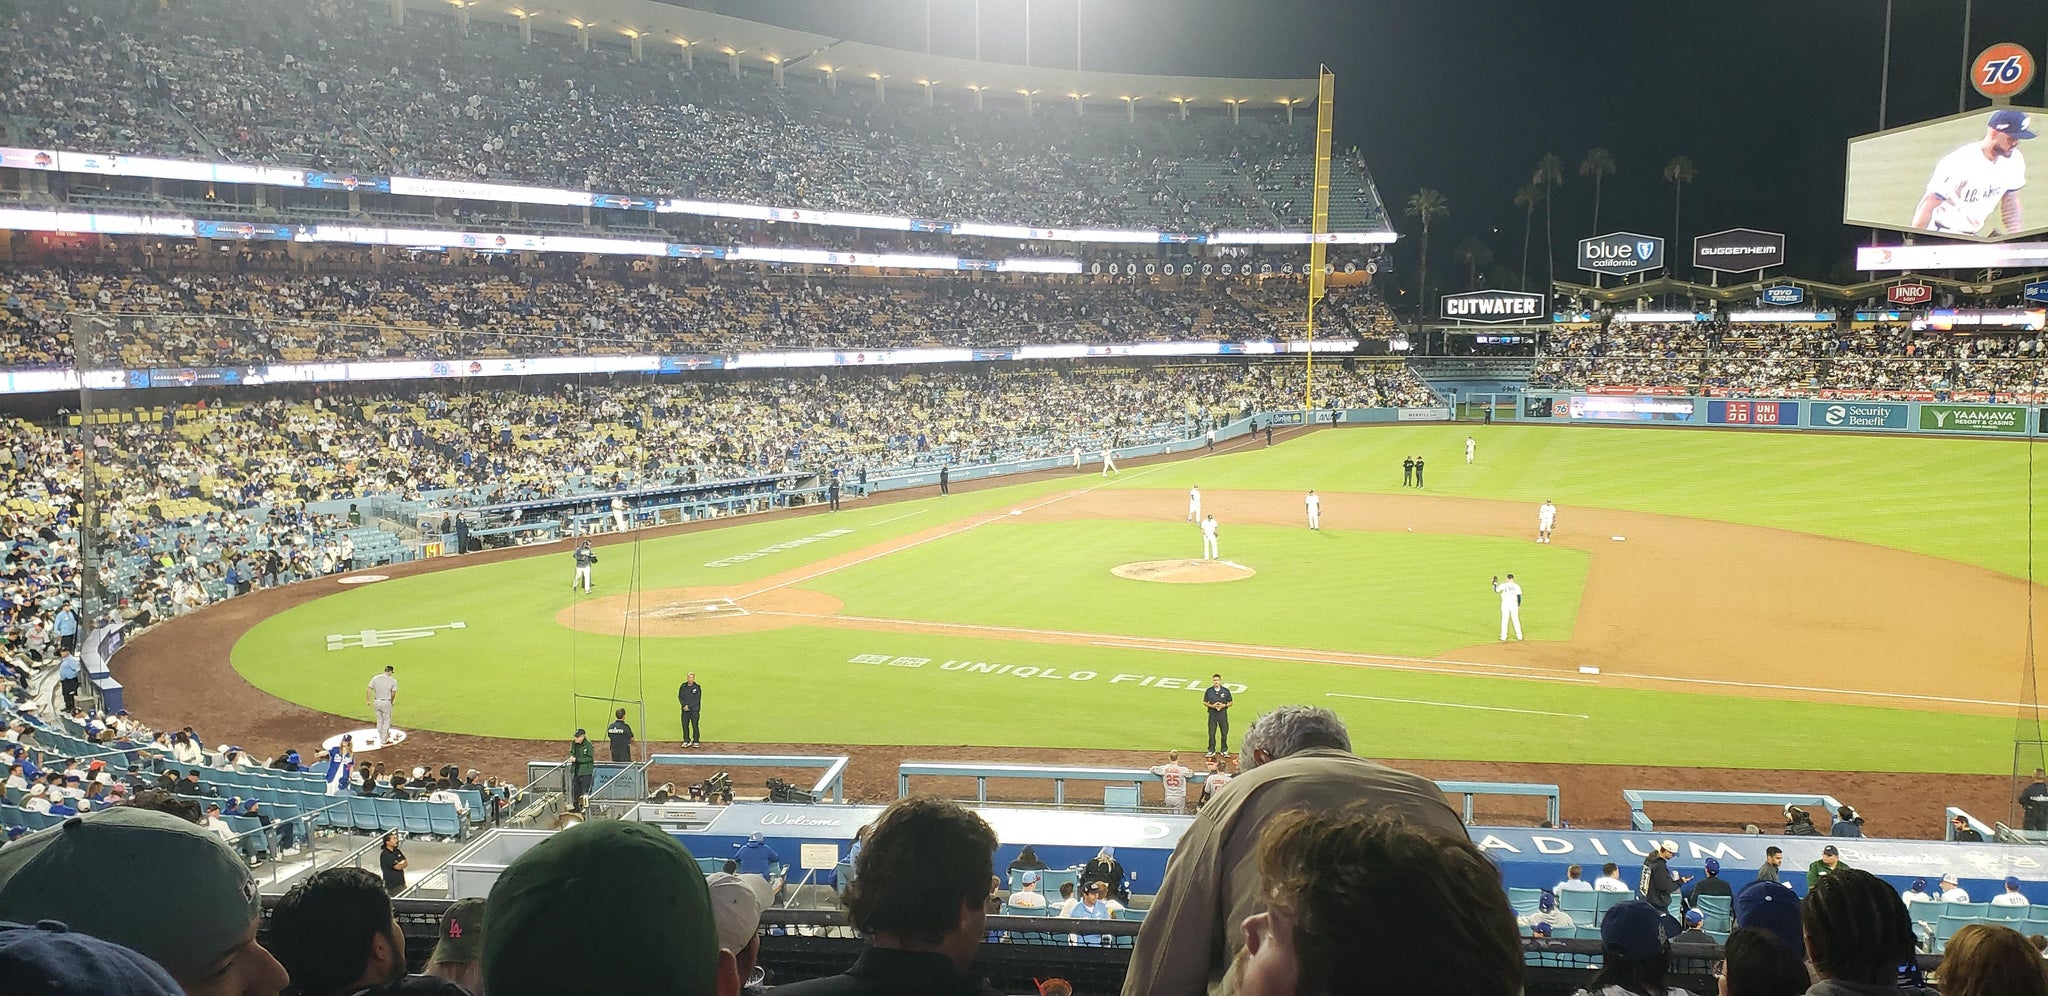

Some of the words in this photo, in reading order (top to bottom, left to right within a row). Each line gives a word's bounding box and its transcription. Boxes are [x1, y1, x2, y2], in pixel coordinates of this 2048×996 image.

[1982, 55, 2022, 85] 76
[463, 234, 476, 246] 29
[1586, 242, 1632, 259] blue
[1701, 246, 1776, 255] GUGGENHEIM
[1593, 259, 1637, 267] california
[1894, 287, 1926, 300] JINRO
[1447, 299, 1536, 315] CUTWATER
[1555, 405, 1567, 414] 76
[1757, 405, 1774, 413] UNI
[1850, 406, 1891, 419] Security
[1757, 413, 1776, 422] QLO
[1850, 416, 1885, 426] Benefit
[940, 660, 1098, 681] UNIQLO
[1166, 774, 1180, 787] 25
[760, 810, 841, 826] Welcome
[449, 918, 462, 938] LA
